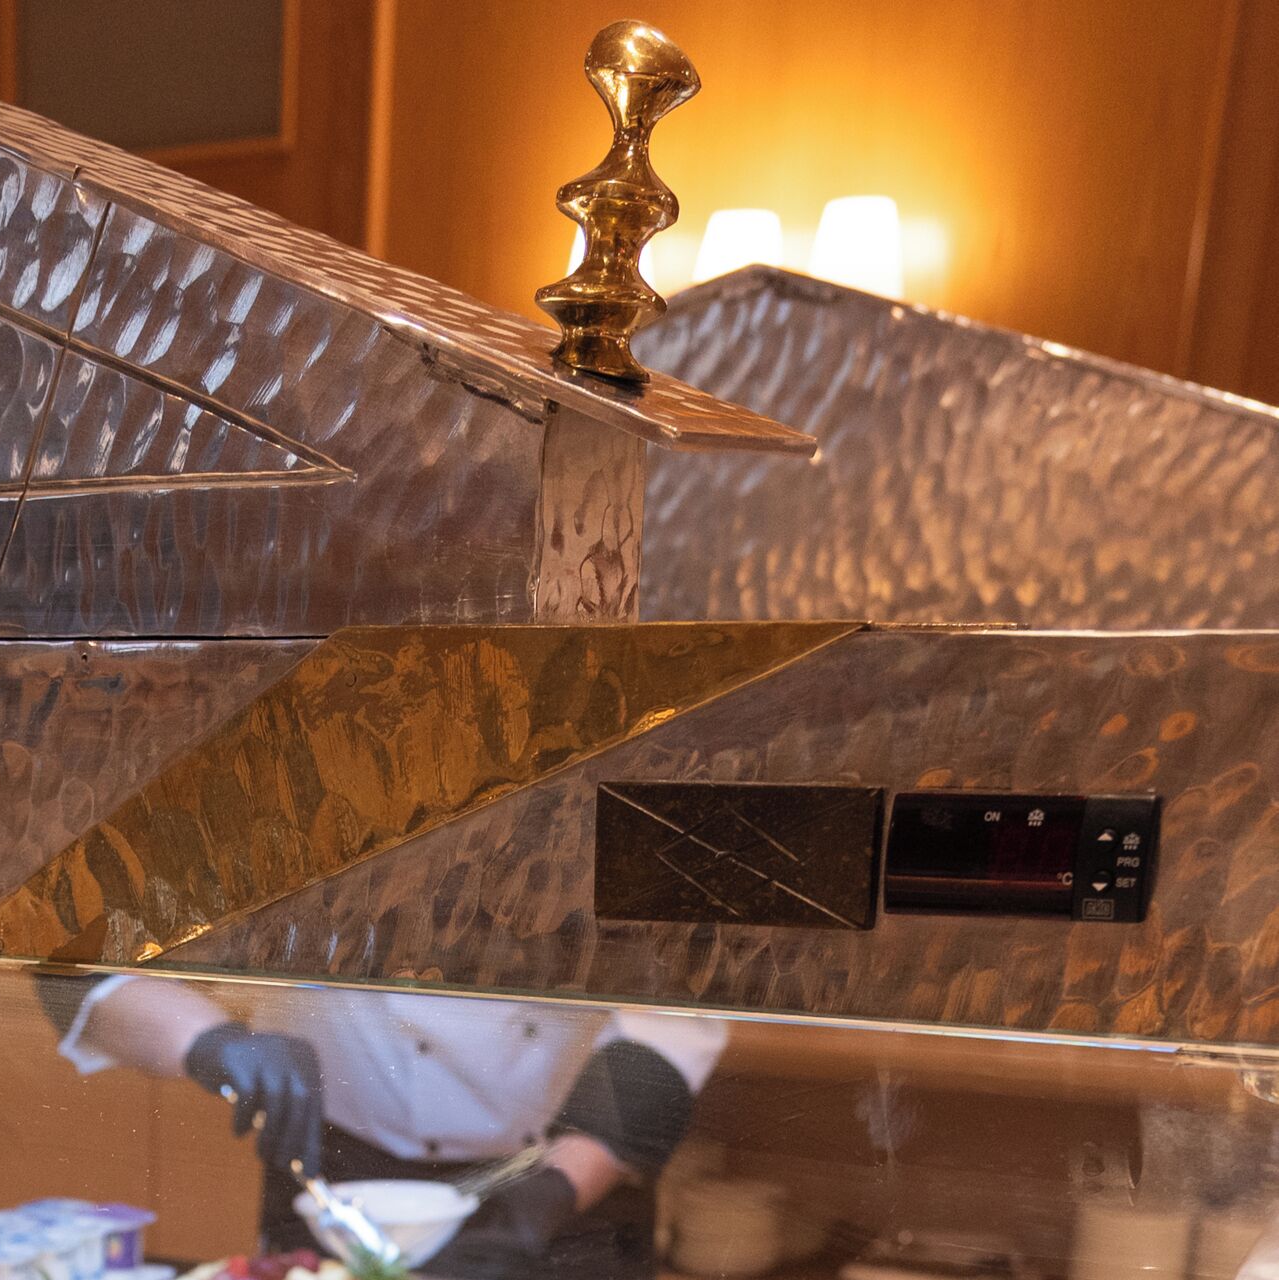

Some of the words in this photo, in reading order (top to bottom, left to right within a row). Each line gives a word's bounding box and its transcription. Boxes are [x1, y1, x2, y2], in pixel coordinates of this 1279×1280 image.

[984, 811, 1001, 822] ON
[1116, 857, 1140, 868] PRG
[1057, 872, 1074, 886] °C
[1115, 877, 1137, 888] SET
